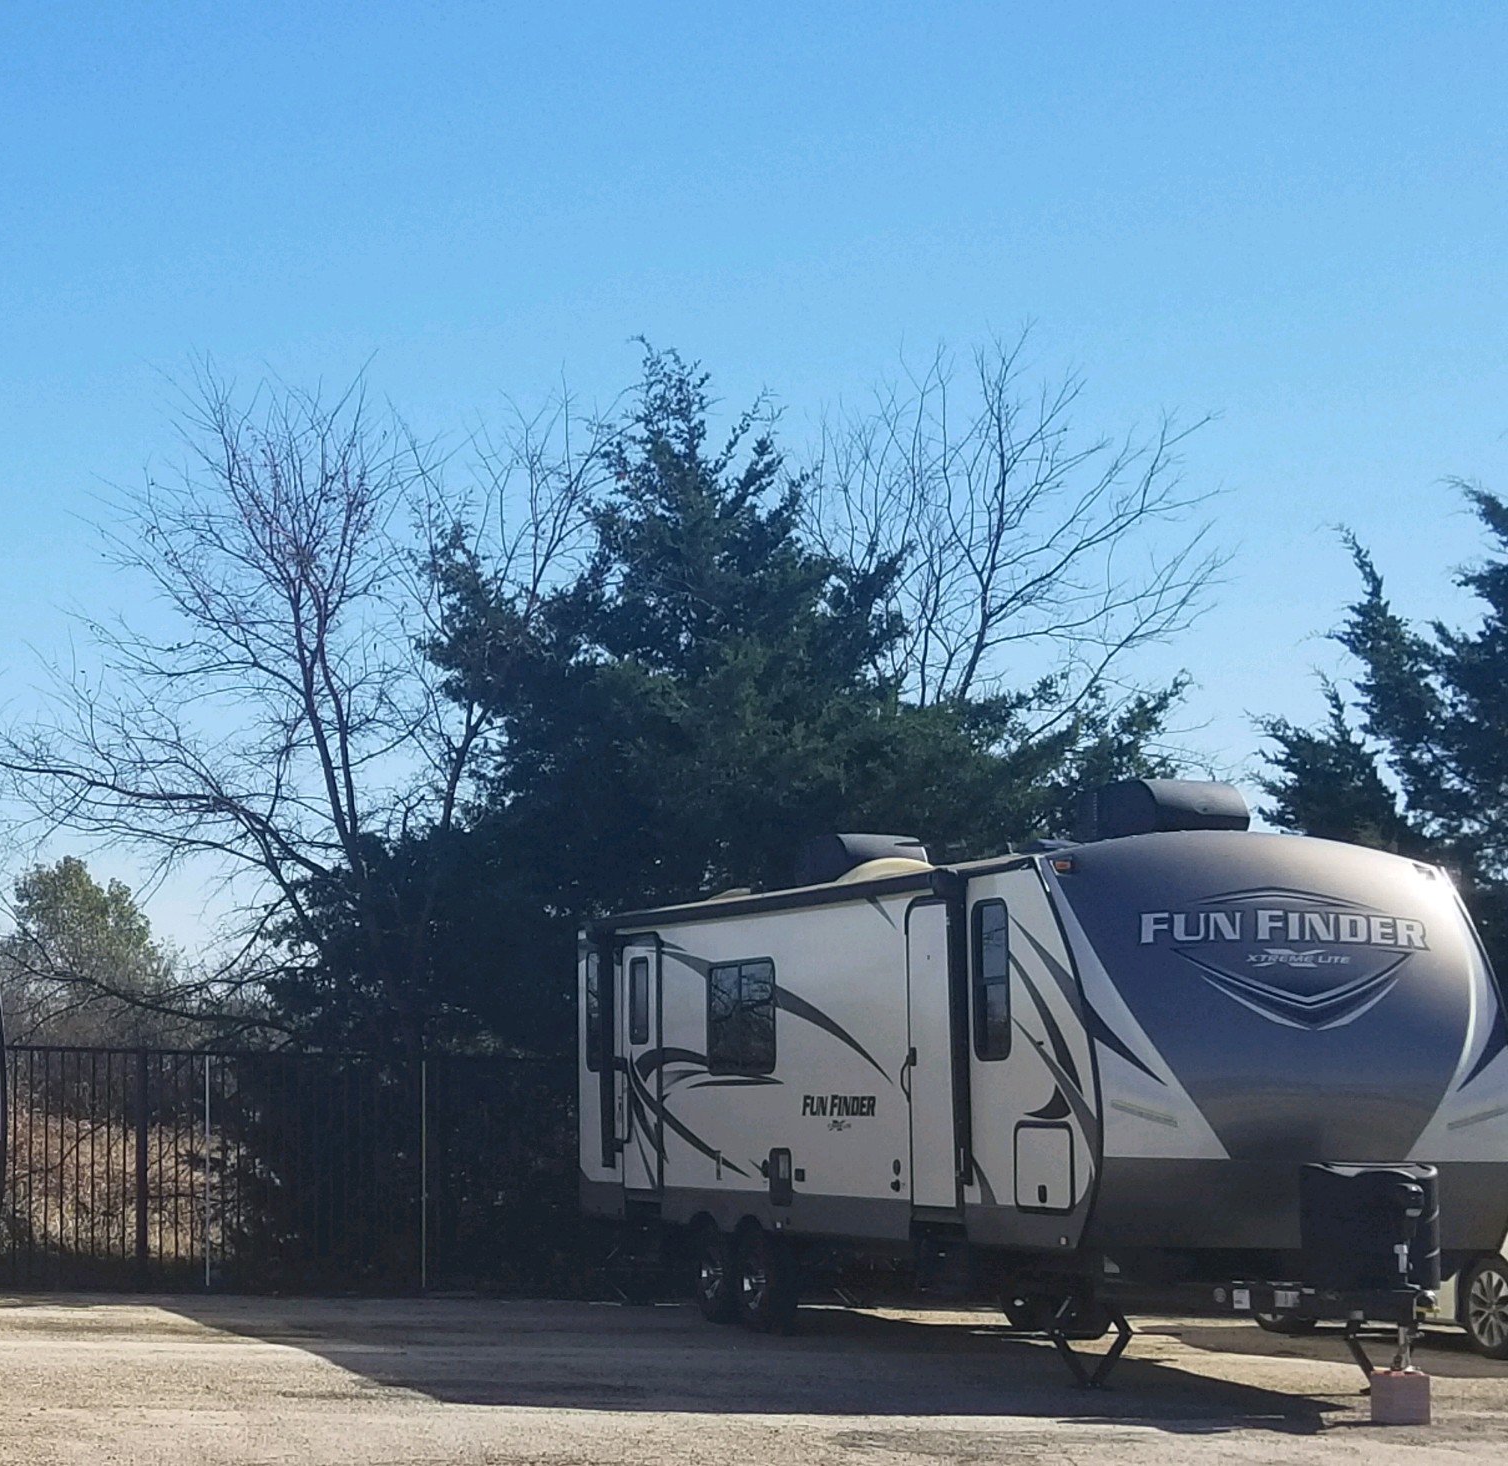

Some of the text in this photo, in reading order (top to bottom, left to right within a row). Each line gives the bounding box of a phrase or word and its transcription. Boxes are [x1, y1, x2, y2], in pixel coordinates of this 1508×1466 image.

[1140, 908, 1431, 951] FUN FINDER
[1245, 953, 1351, 965] XTREME LITE
[802, 1094, 876, 1117] FUN FINDER
